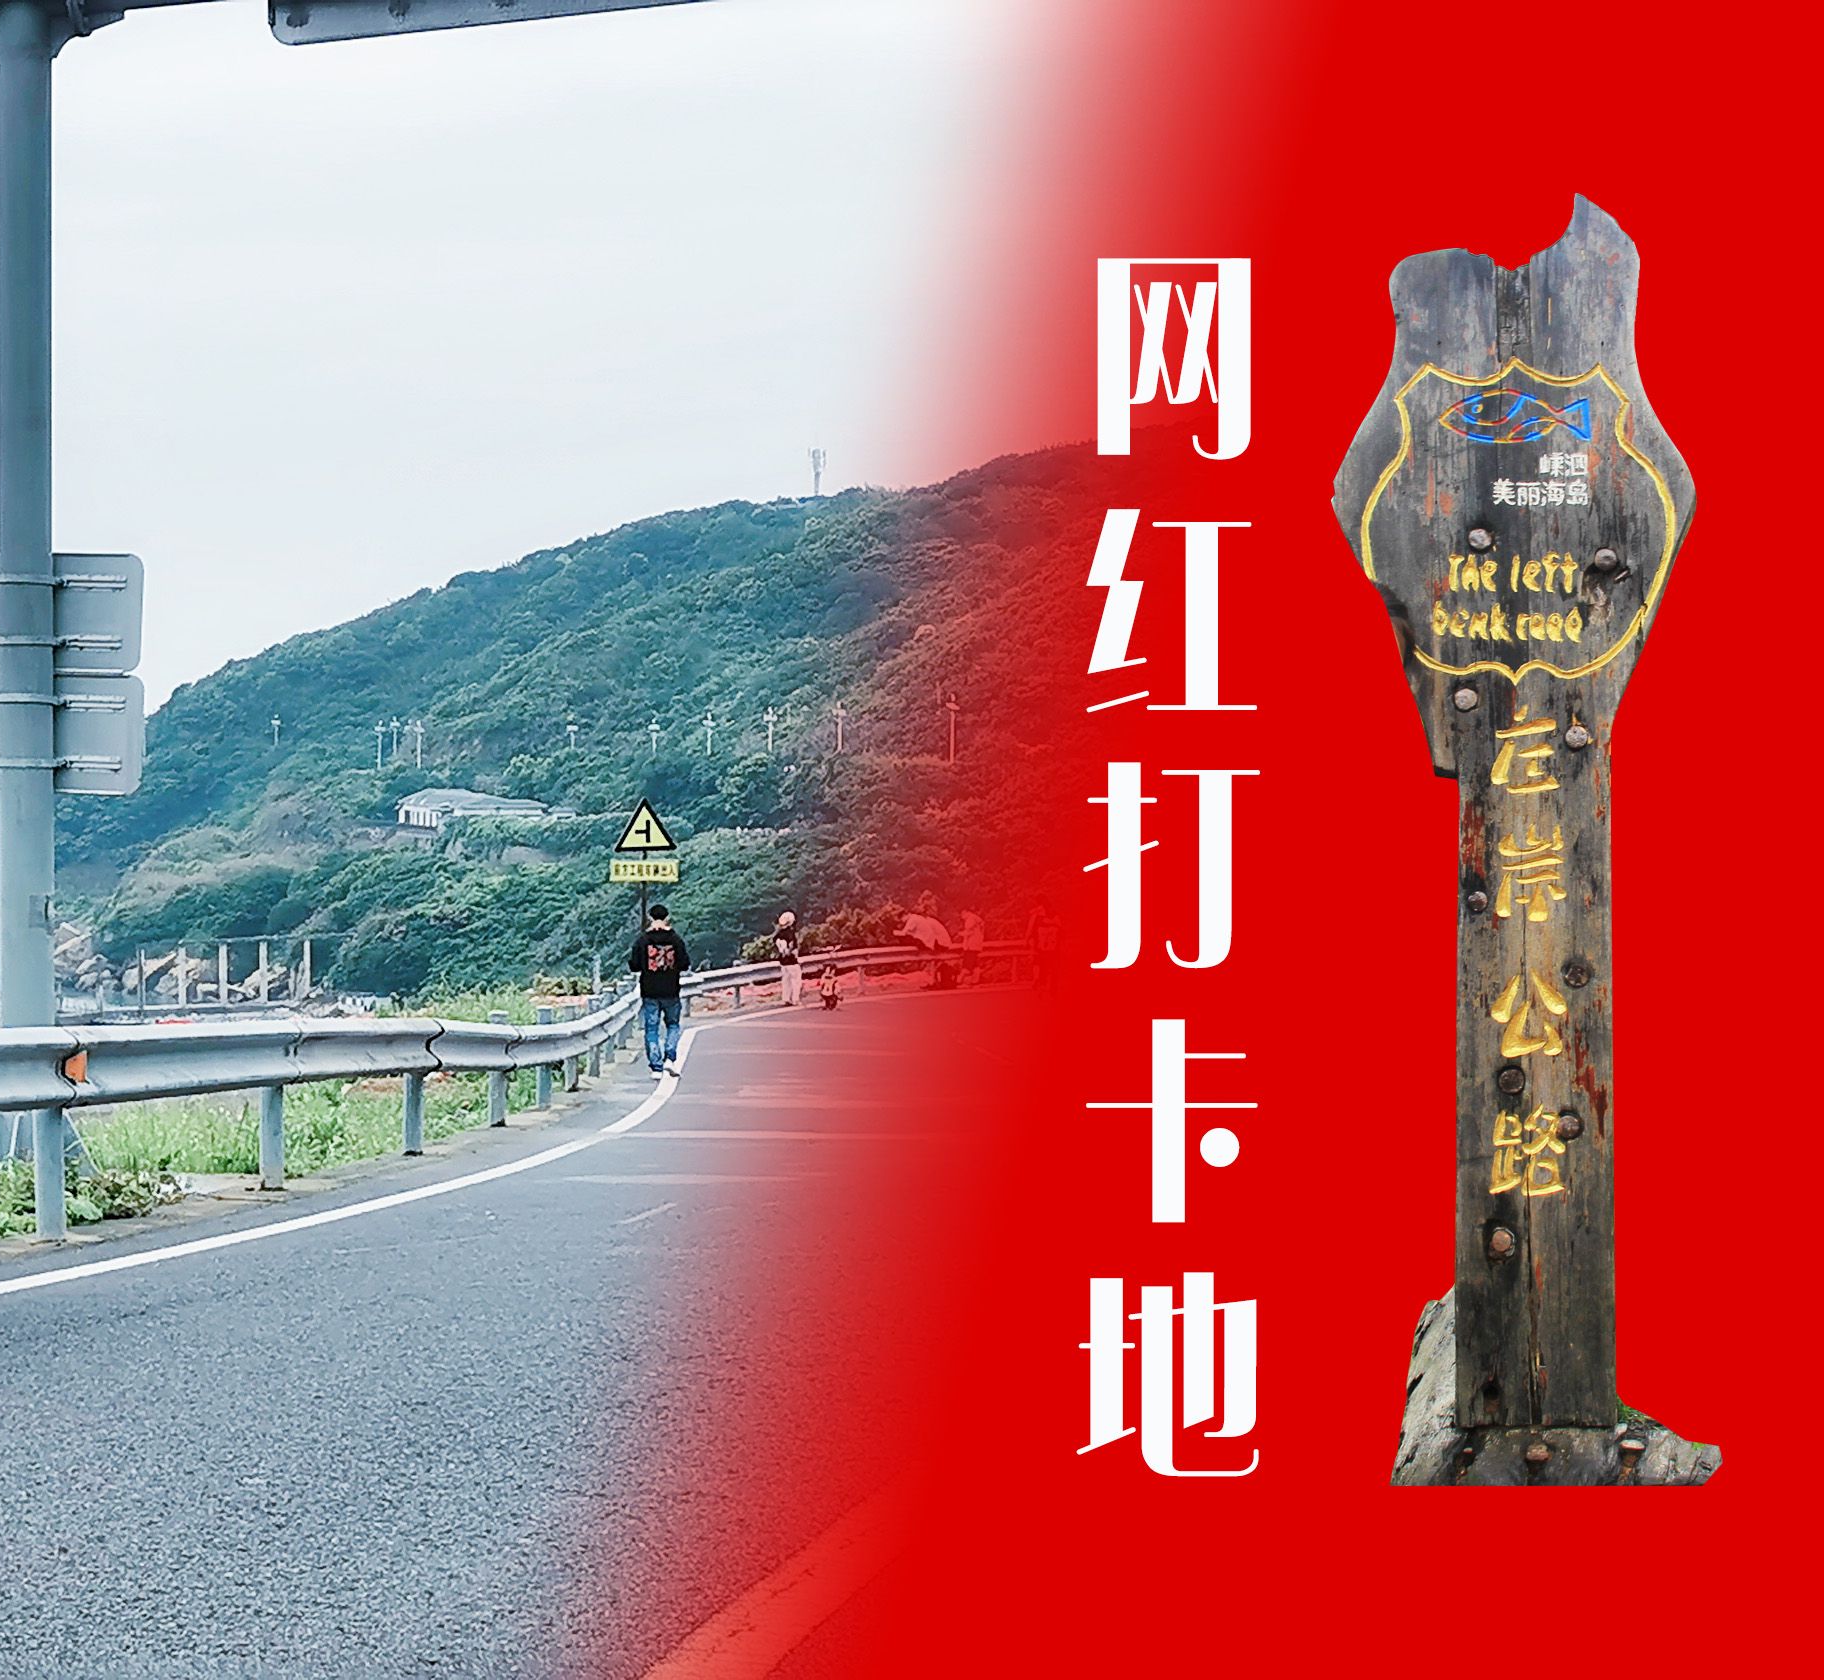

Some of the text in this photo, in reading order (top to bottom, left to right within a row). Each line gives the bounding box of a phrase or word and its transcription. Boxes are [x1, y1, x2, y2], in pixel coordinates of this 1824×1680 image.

[1492, 478, 1589, 507] 美丽海岛
[1510, 551, 1578, 593] left
[1490, 706, 1568, 1197] 左岸公路
